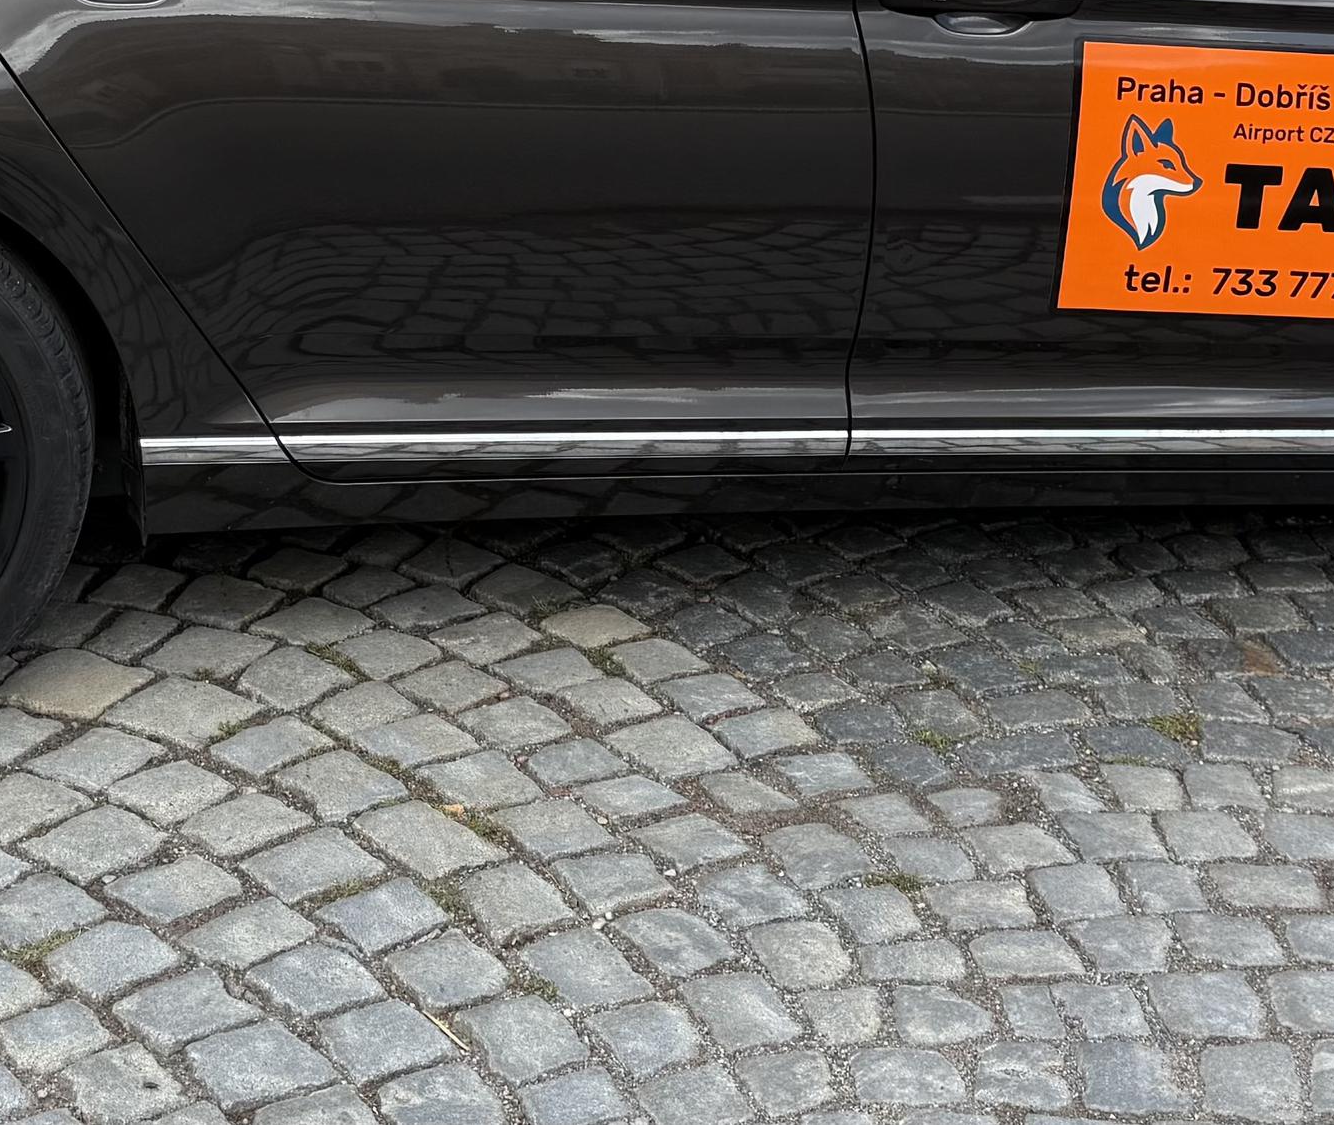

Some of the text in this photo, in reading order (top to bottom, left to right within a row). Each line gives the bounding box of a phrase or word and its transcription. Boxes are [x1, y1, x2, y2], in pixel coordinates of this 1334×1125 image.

[1117, 76, 1204, 104] Praha
[1236, 82, 1331, 111] Dobříš
[1233, 123, 1304, 144] Airport
[1124, 264, 1192, 293] tel.:
[1212, 268, 1279, 297] 733
